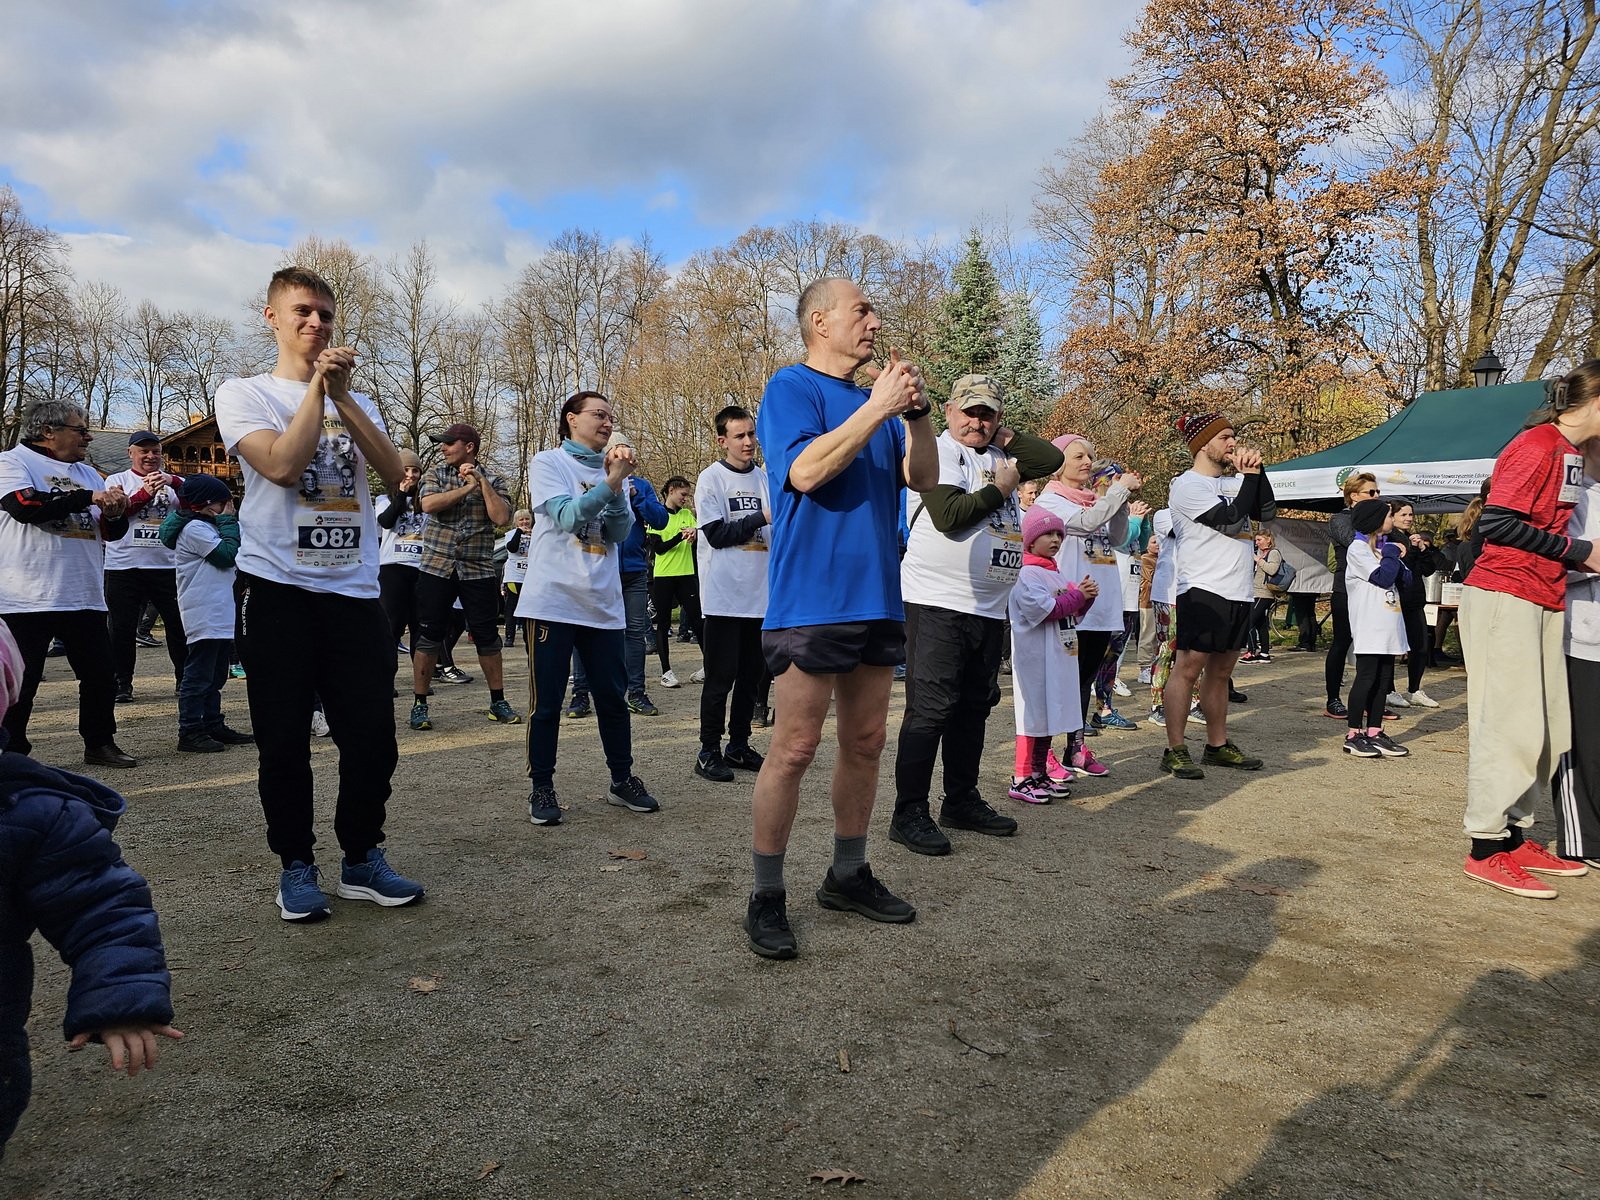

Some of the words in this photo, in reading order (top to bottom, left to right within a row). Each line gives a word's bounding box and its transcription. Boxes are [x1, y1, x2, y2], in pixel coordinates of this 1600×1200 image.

[1273, 481, 1296, 489] CIEPLICE
[736, 497, 758, 510] 156
[139, 529, 160, 539] 177
[310, 528, 355, 548] 082
[400, 544, 418, 553] 176
[999, 550, 1022, 568] 002
